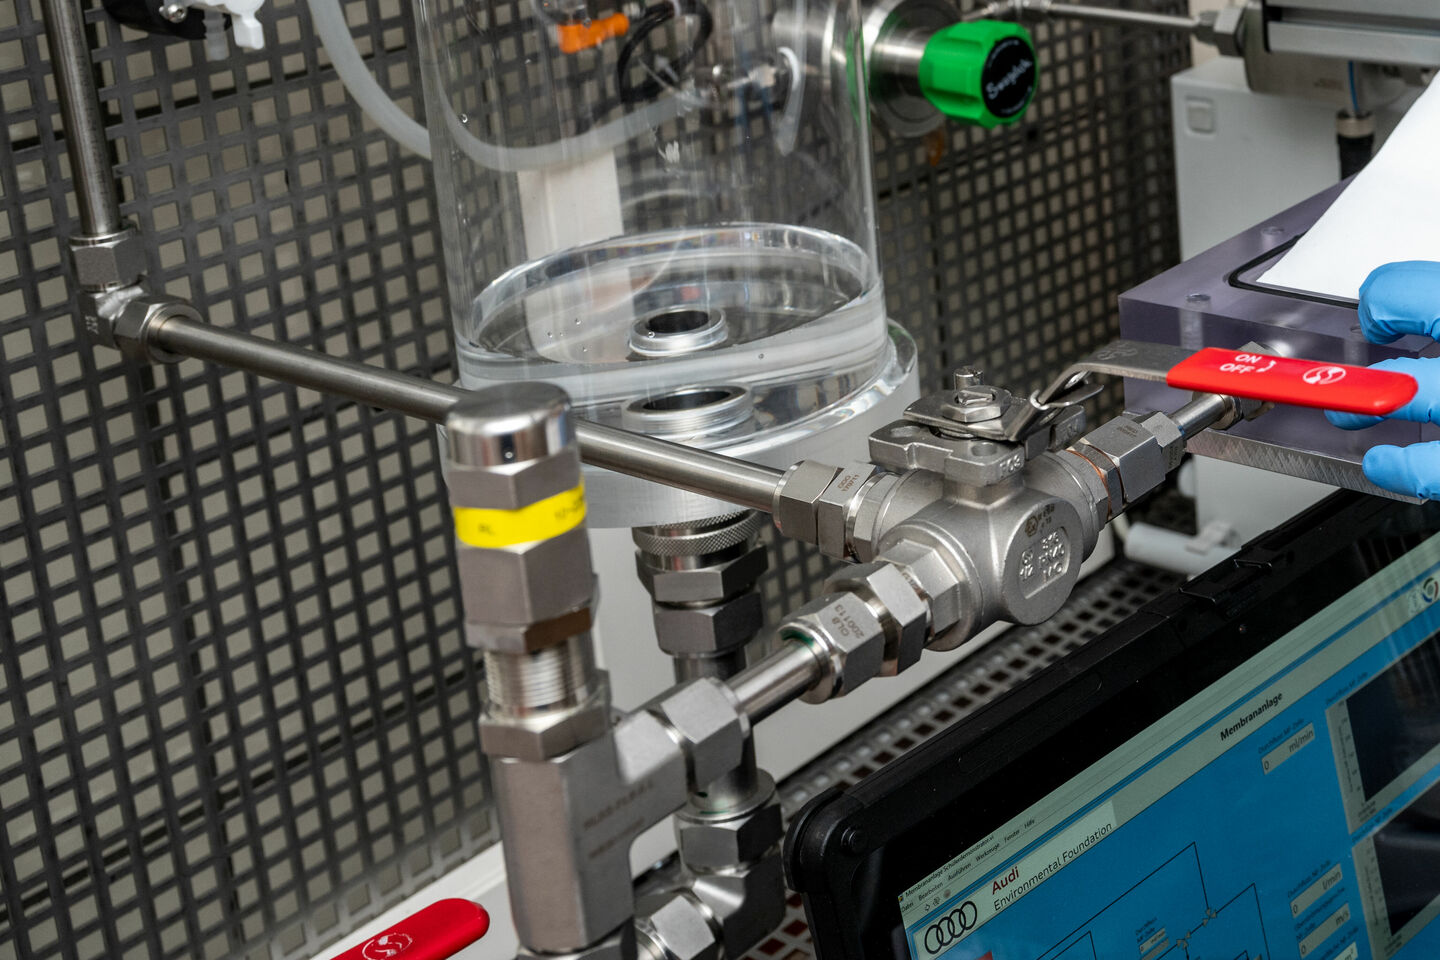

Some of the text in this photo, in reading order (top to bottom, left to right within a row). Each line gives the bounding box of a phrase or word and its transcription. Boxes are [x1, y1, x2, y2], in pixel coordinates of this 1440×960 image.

[1219, 363, 1255, 374] OFF
[1235, 354, 1262, 364] ON
[1220, 692, 1283, 741] Membrananlage
[1263, 760, 1270, 771] 0
[993, 823, 1112, 911] Environmental Foundation
[991, 866, 1020, 895] Audi
